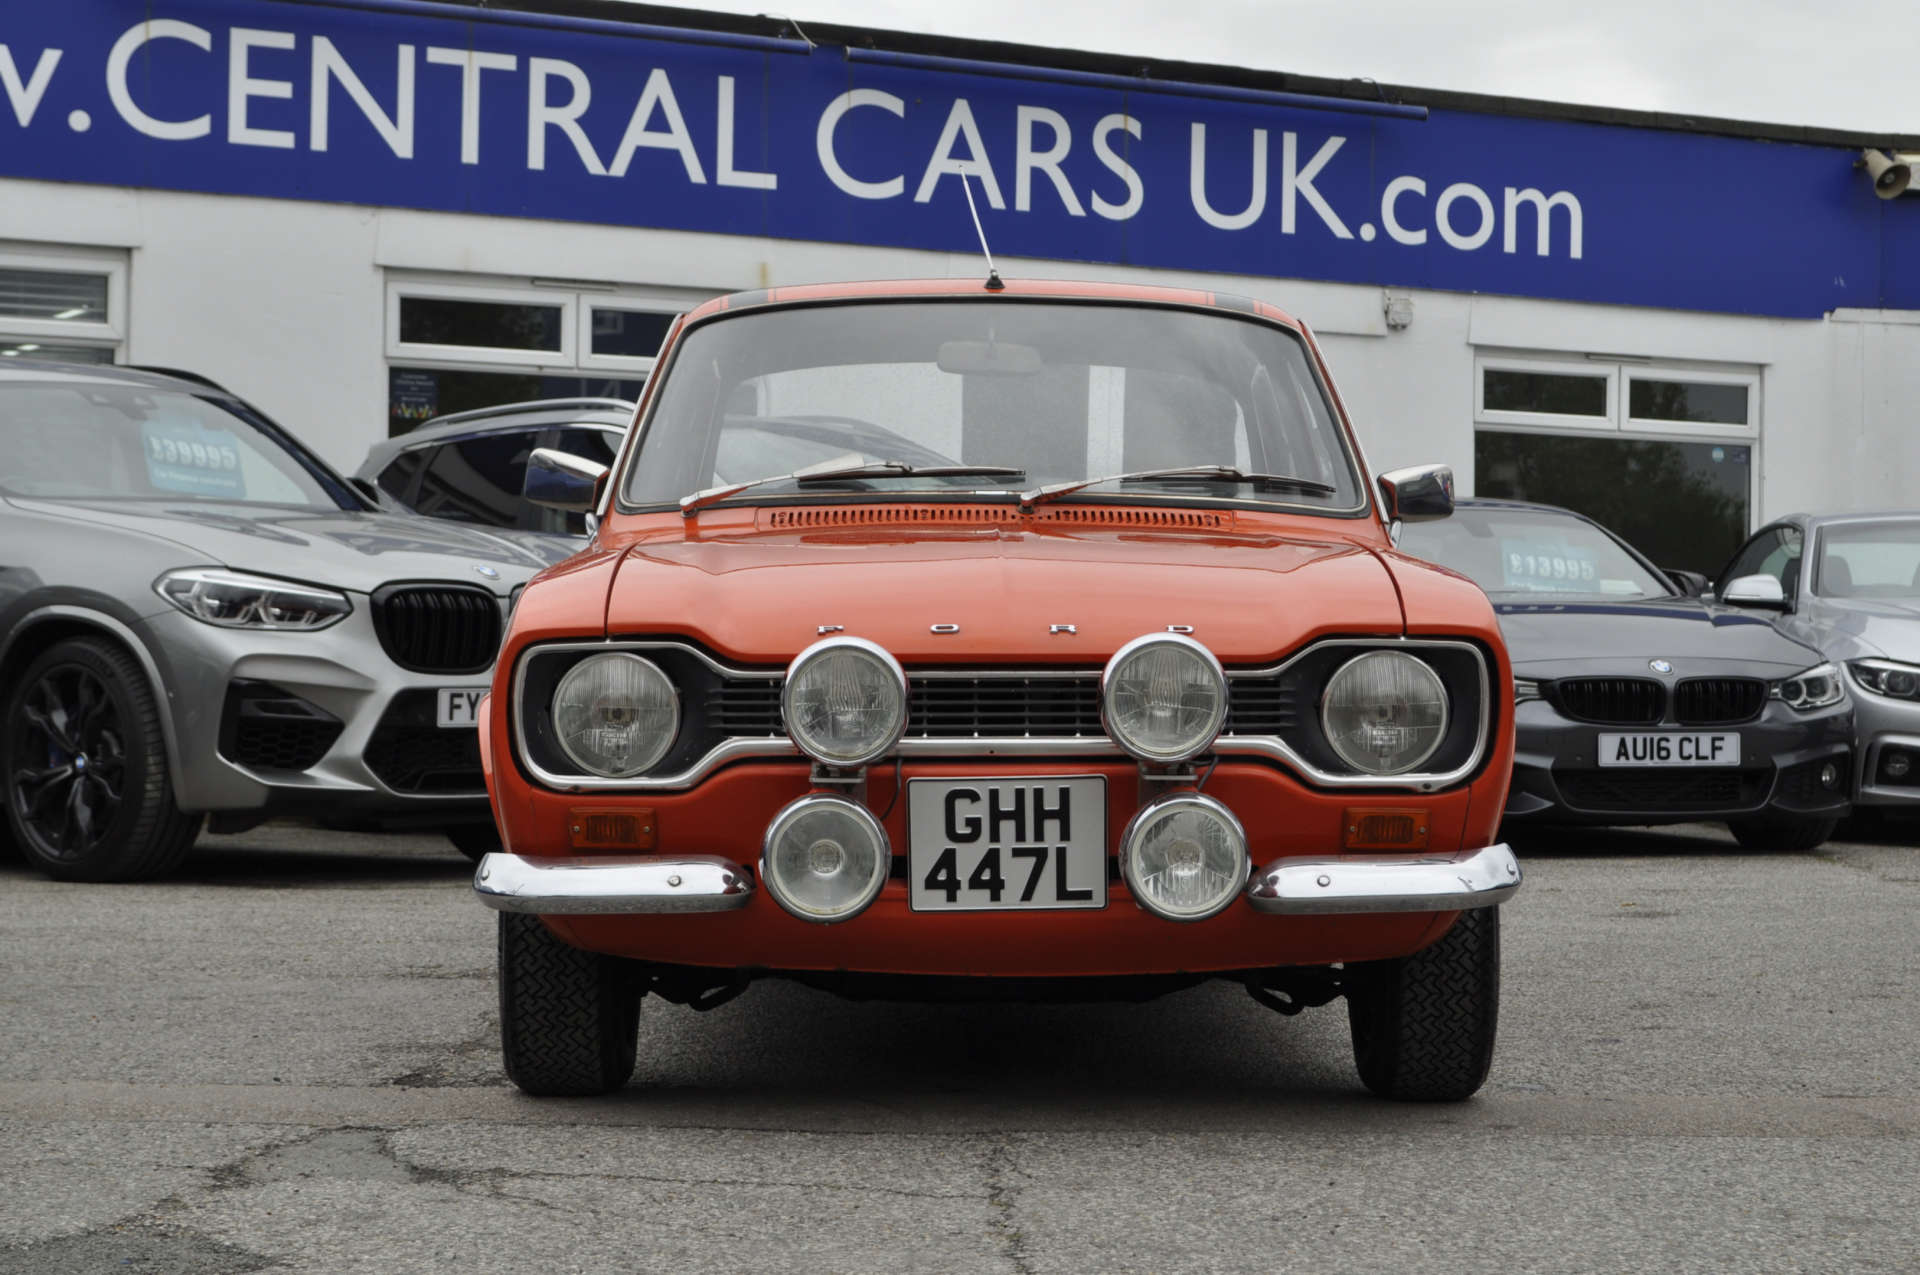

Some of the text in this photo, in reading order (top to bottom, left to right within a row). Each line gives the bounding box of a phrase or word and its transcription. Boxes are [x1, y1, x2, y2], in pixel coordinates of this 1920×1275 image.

[816, 89, 1145, 222] CARS
[1190, 123, 1584, 260] UK.com
[1615, 736, 1725, 761] AU16 CLF
[944, 786, 1071, 844] GHH
[924, 846, 1093, 903] 447L
